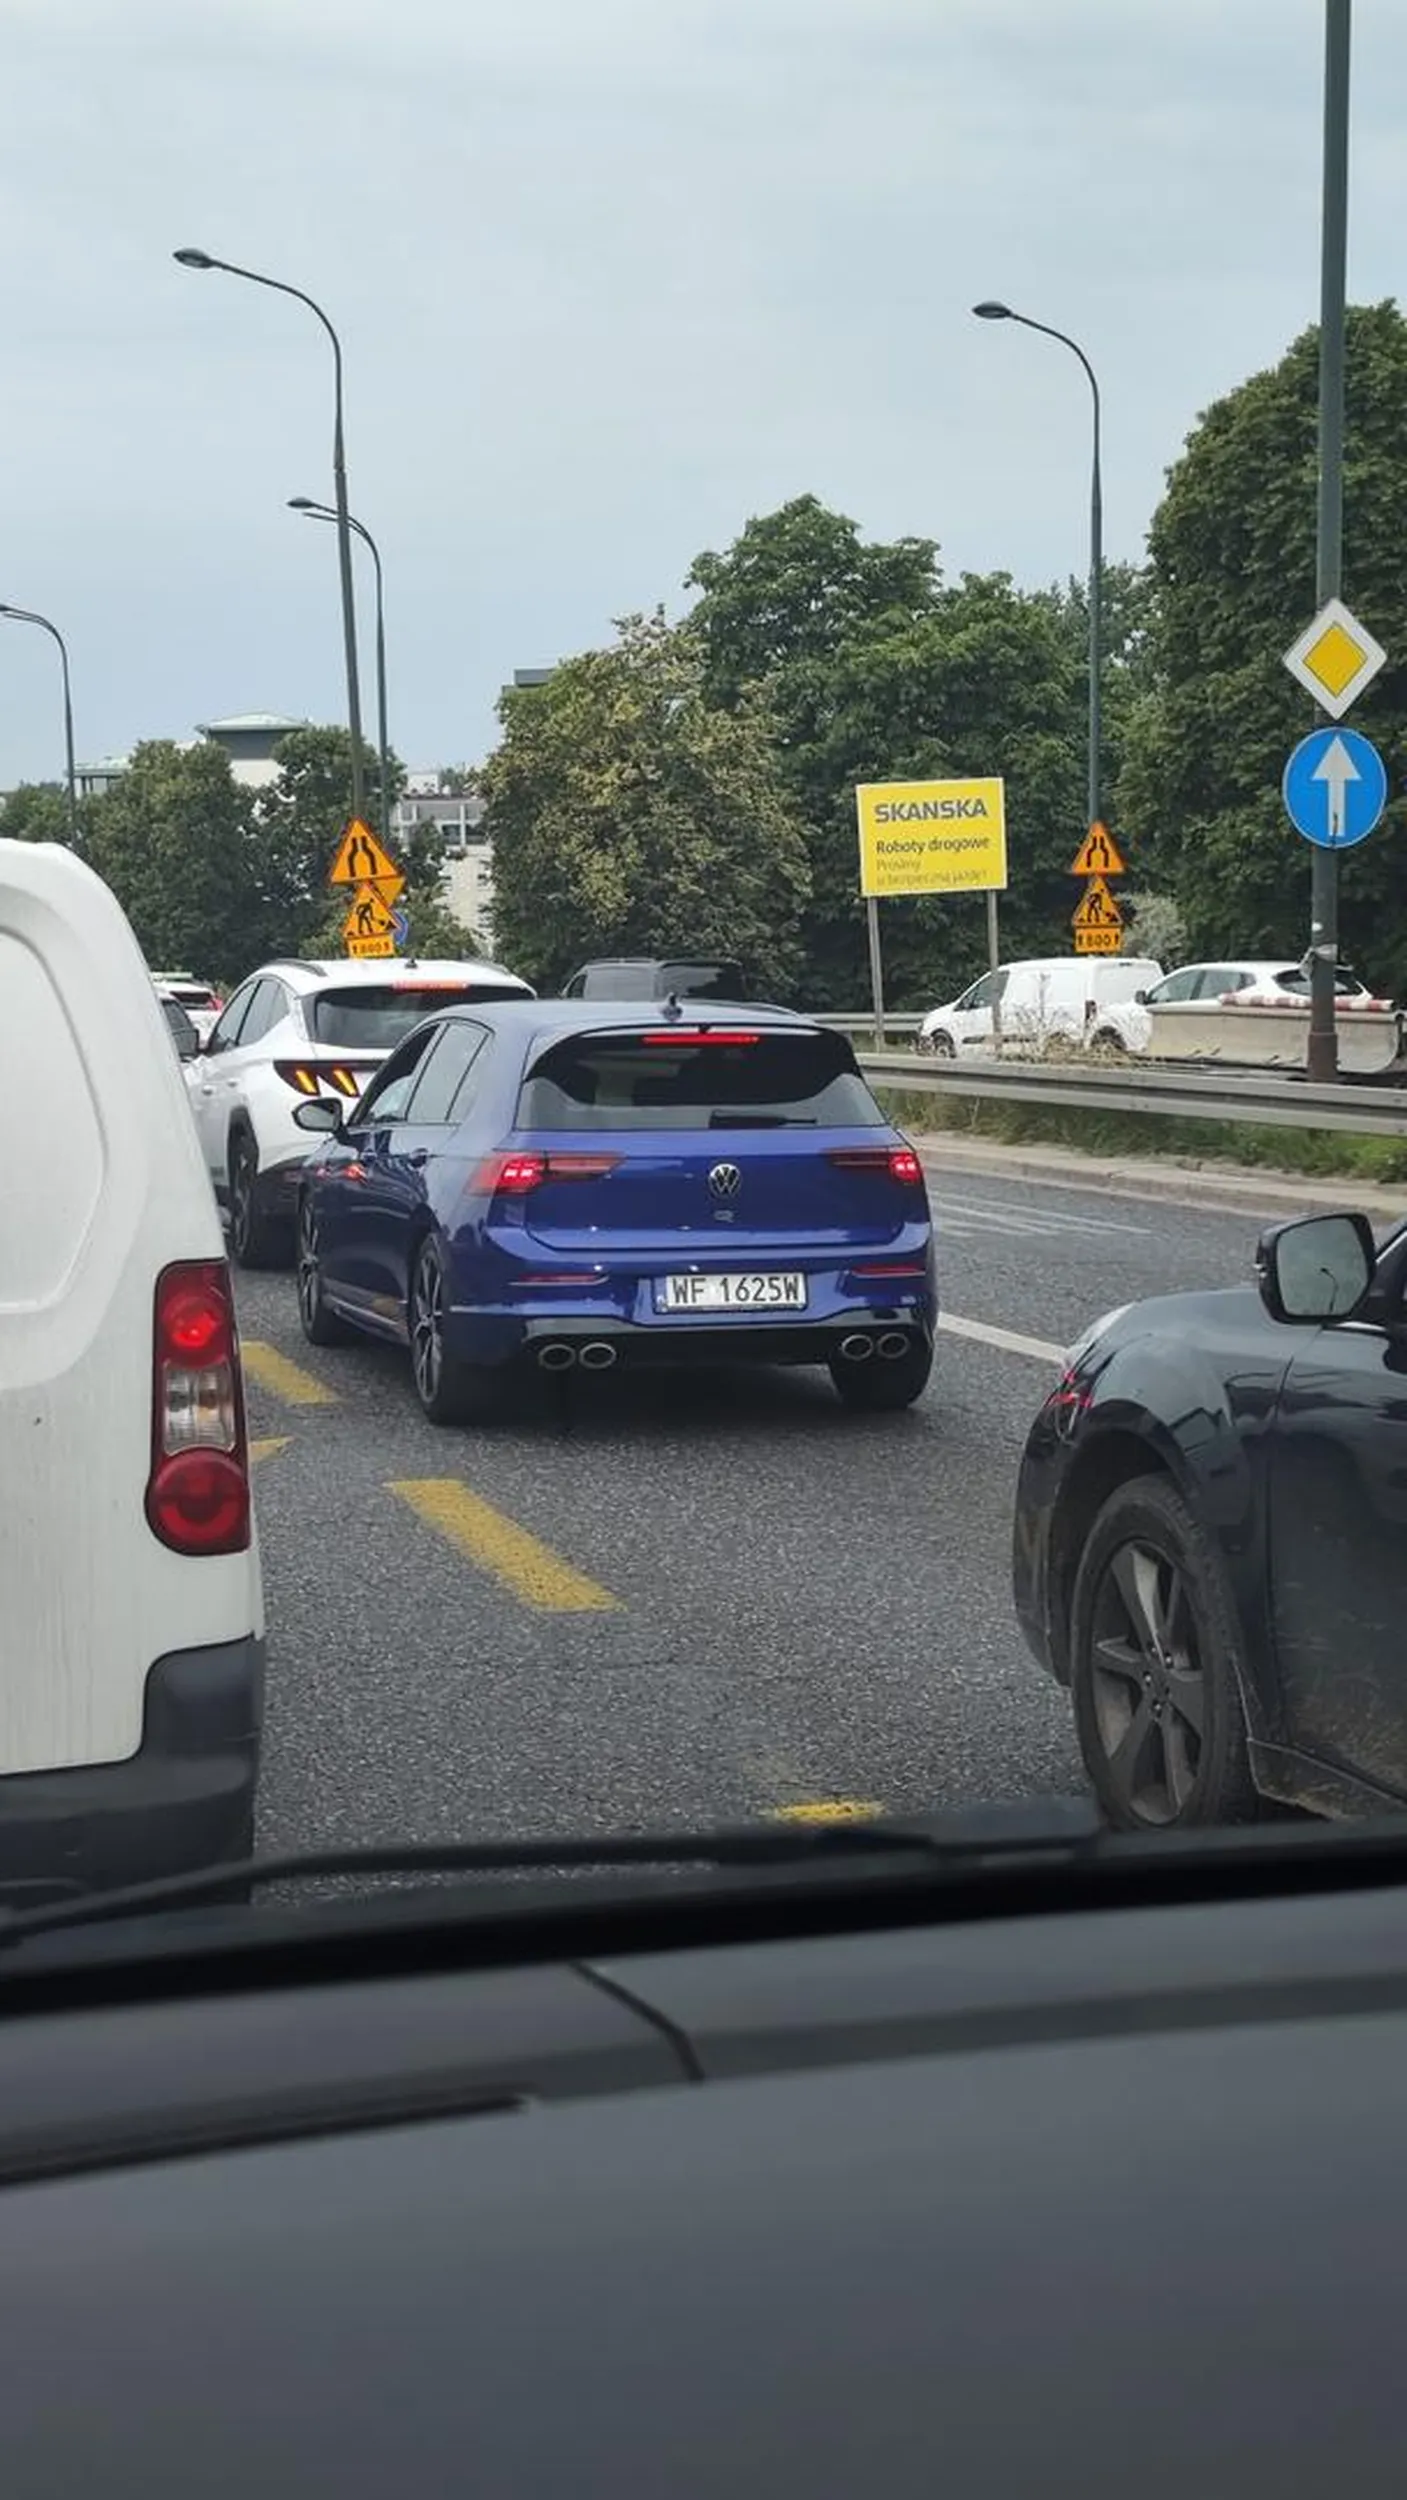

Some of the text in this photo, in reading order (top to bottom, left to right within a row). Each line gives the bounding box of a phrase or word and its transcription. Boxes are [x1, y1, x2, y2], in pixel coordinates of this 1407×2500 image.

[874, 798, 988, 823] SKANSKA
[876, 836, 990, 855] Roboty drogowe
[672, 1275, 800, 1304] WF 1625W
